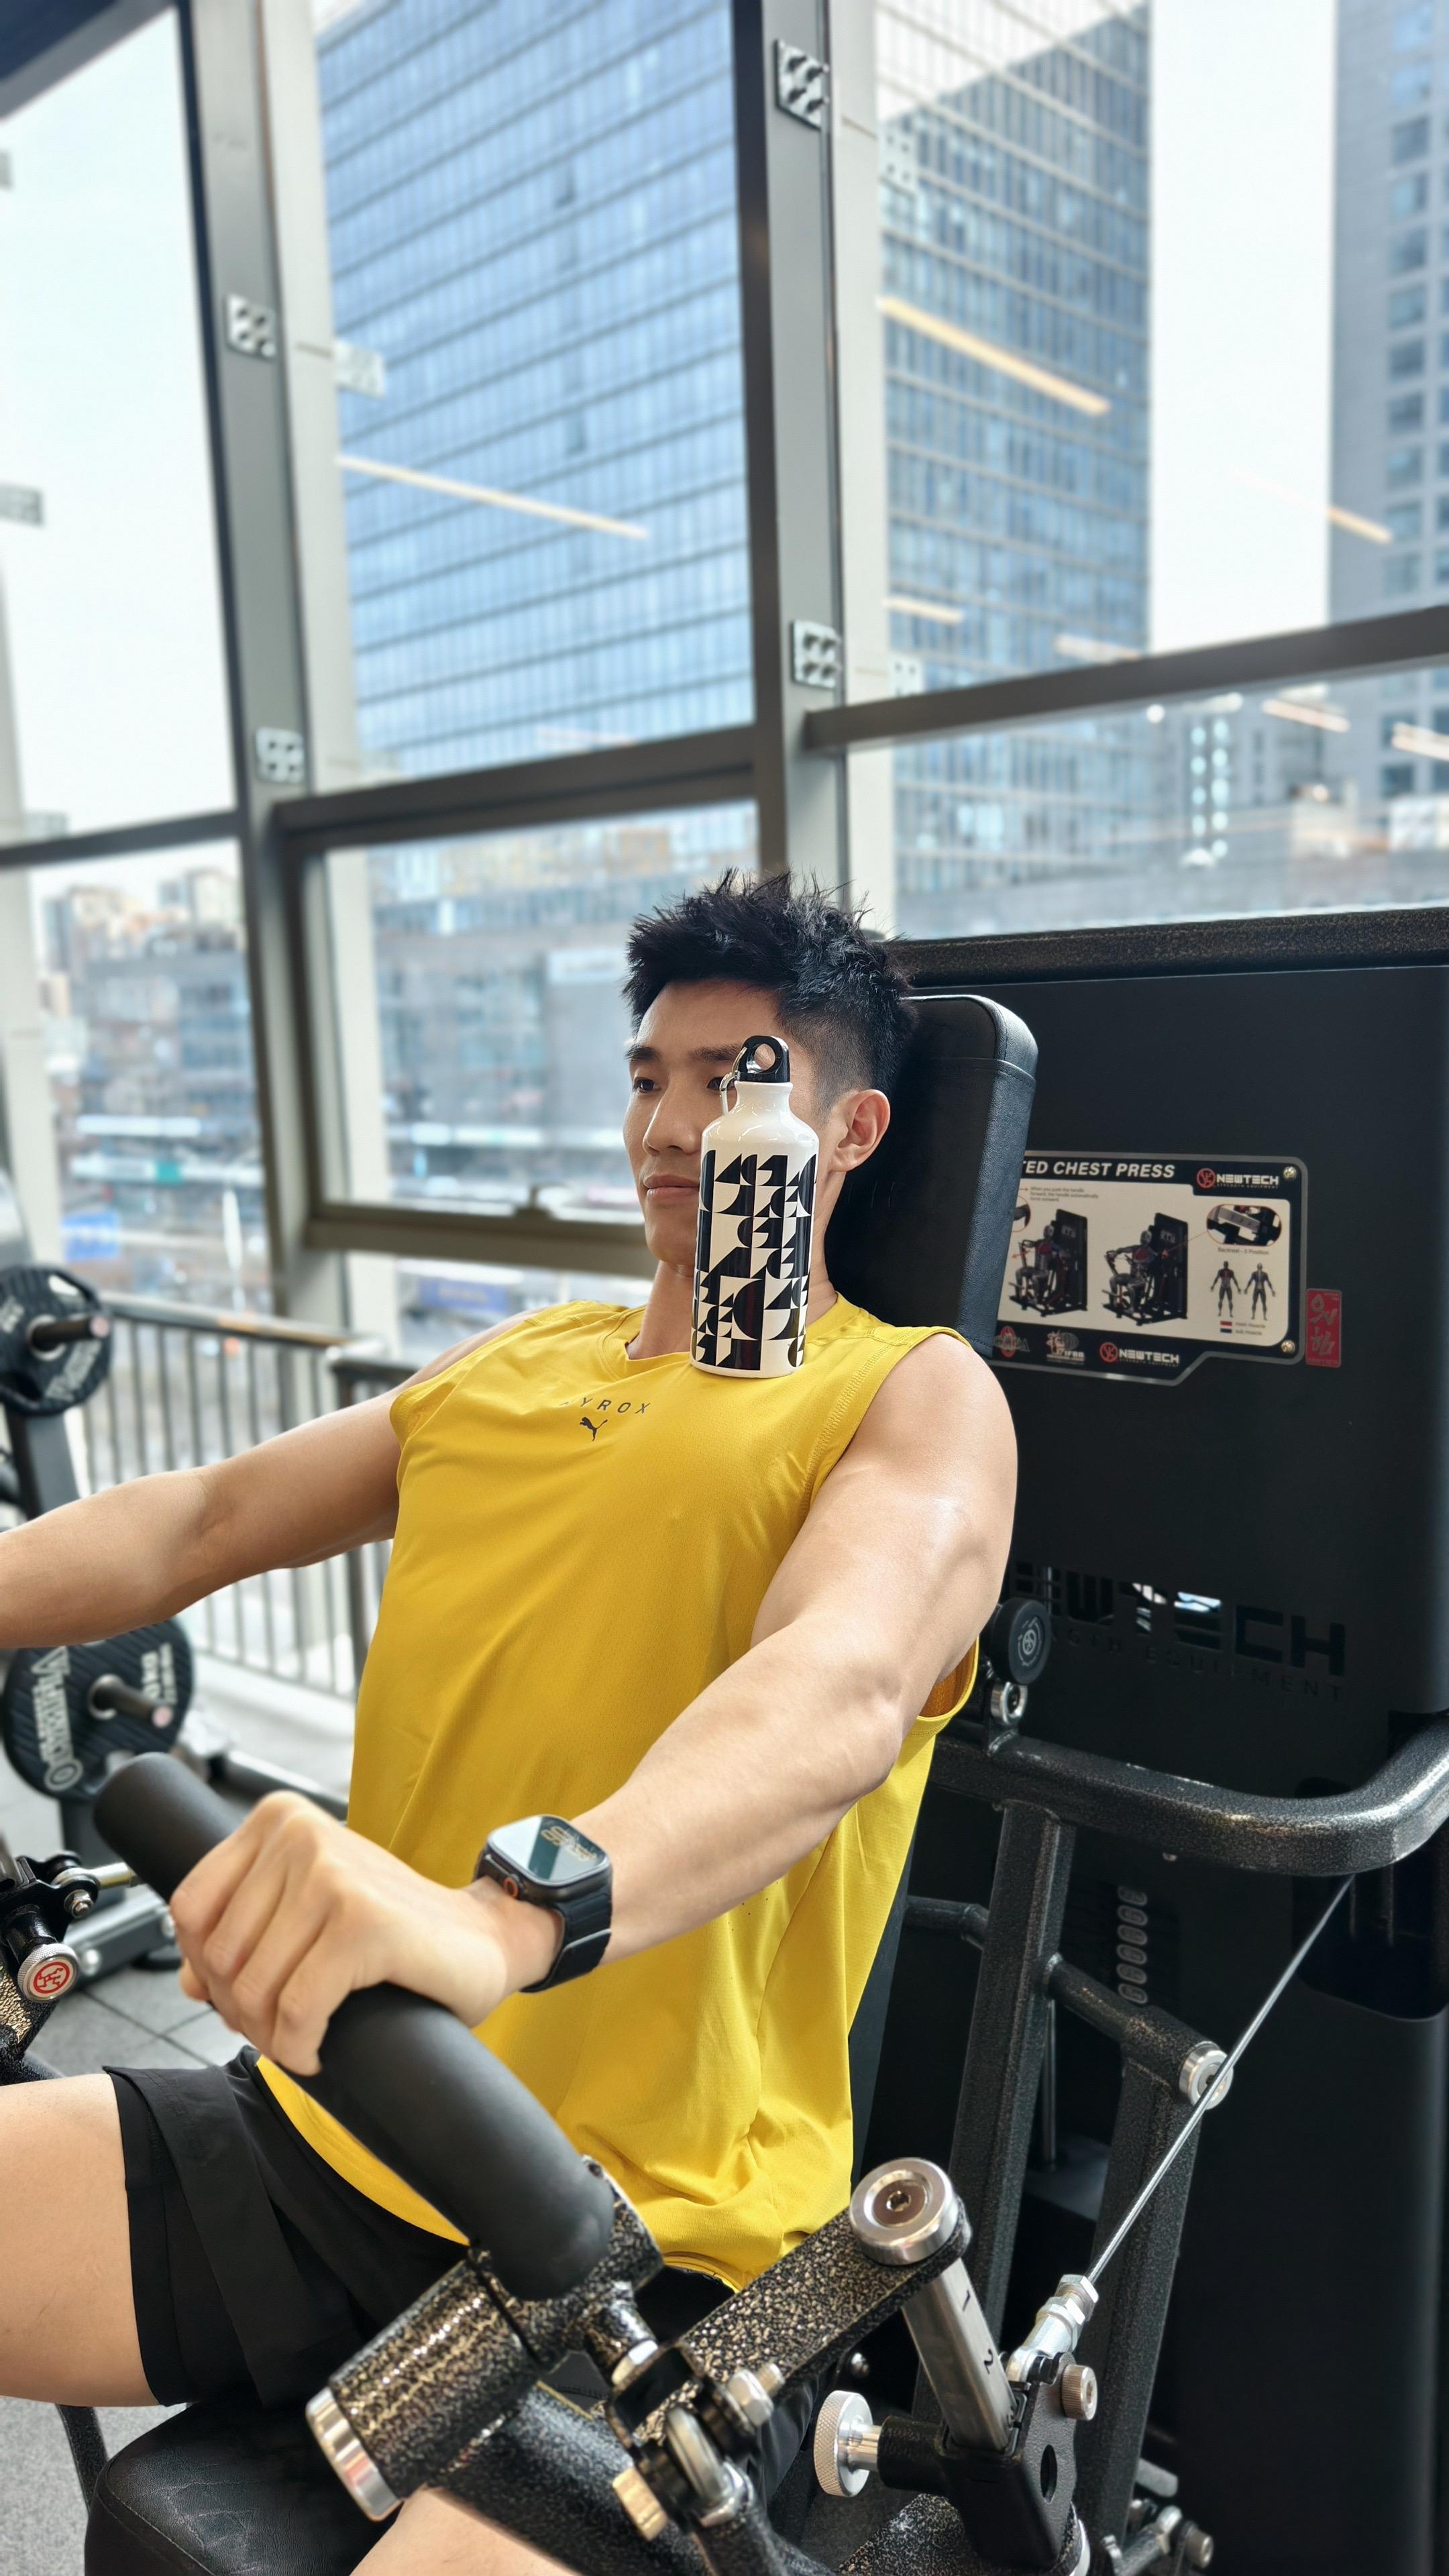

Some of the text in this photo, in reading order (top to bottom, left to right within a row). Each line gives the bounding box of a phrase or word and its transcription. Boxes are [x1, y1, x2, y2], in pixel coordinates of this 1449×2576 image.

[1024, 1161, 1175, 1178] ED CHEST PRESS
[1216, 1173, 1279, 1185] NEWTECH
[1119, 1348, 1179, 1364] NEWTECH
[1014, 1560, 1345, 1677] EWTECH
[962, 2289, 971, 2312] 1
[983, 2348, 994, 2375] 2
